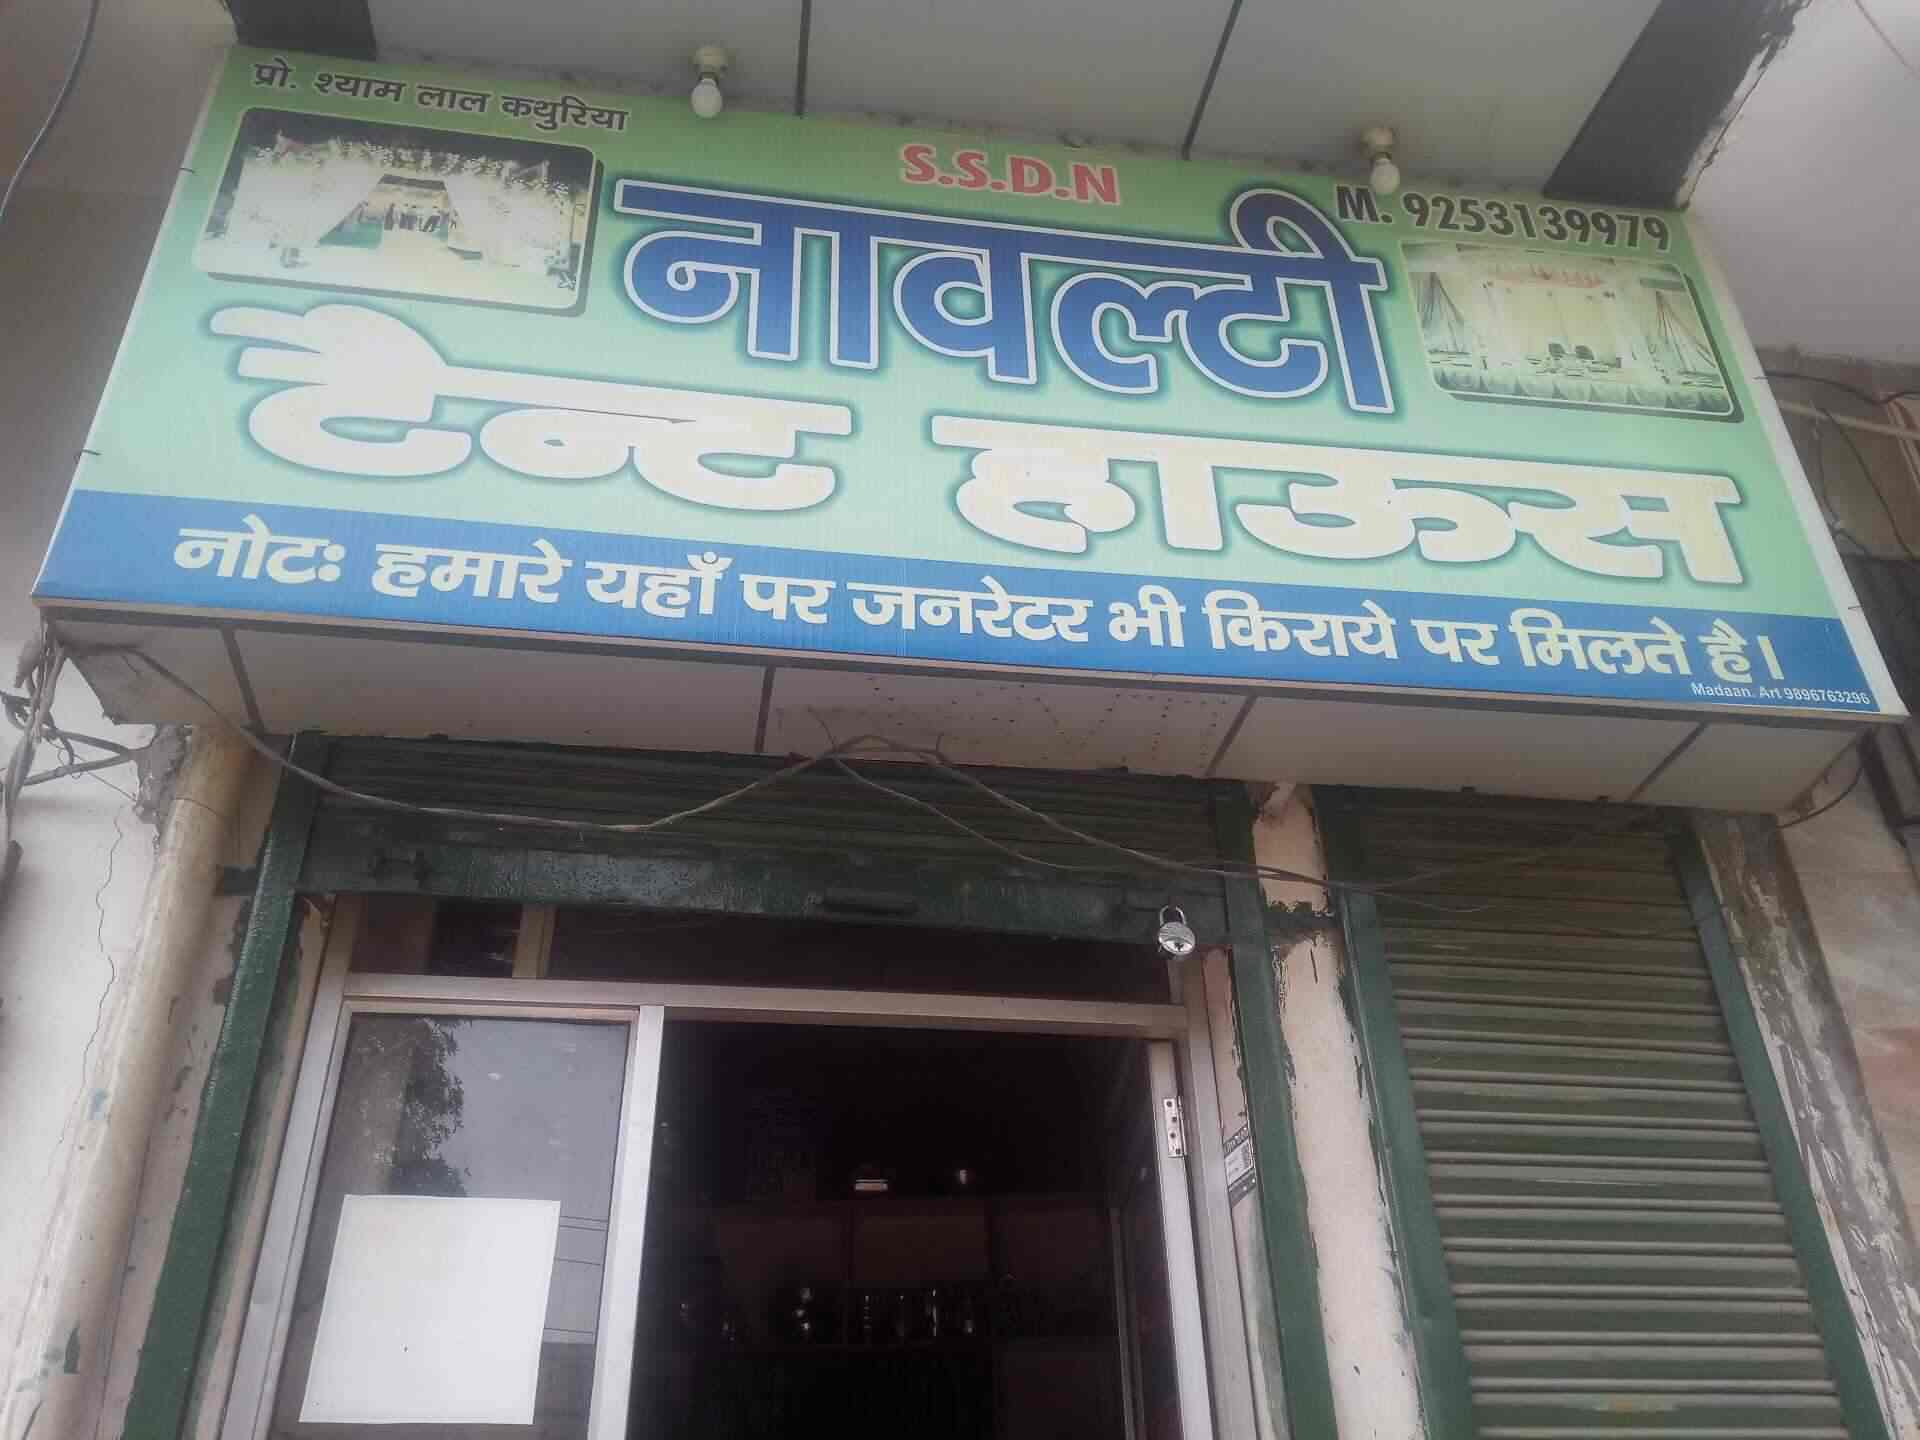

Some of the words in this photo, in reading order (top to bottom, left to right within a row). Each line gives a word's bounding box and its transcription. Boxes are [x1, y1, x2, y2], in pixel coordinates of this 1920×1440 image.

[254, 57, 297, 90] प्रो.
[314, 71, 406, 103] श्याम
[416, 83, 492, 114] लाल
[501, 94, 630, 131] कथुरिया
[900, 143, 1120, 205] S.S.D.N
[1335, 184, 1394, 225] M.
[1401, 191, 1670, 252] 9253139979
[614, 178, 1395, 414] नावल्टी
[930, 415, 1744, 585] हाऊस
[371, 538, 573, 604] हमारे
[585, 551, 734, 618] यहाँ
[740, 573, 837, 625] पर
[846, 575, 1094, 642] जनरेटर
[1108, 584, 1187, 649] भी
[1200, 588, 1400, 660] किराये
[1409, 616, 1502, 666] पर
[1508, 607, 1693, 676] मिलते
